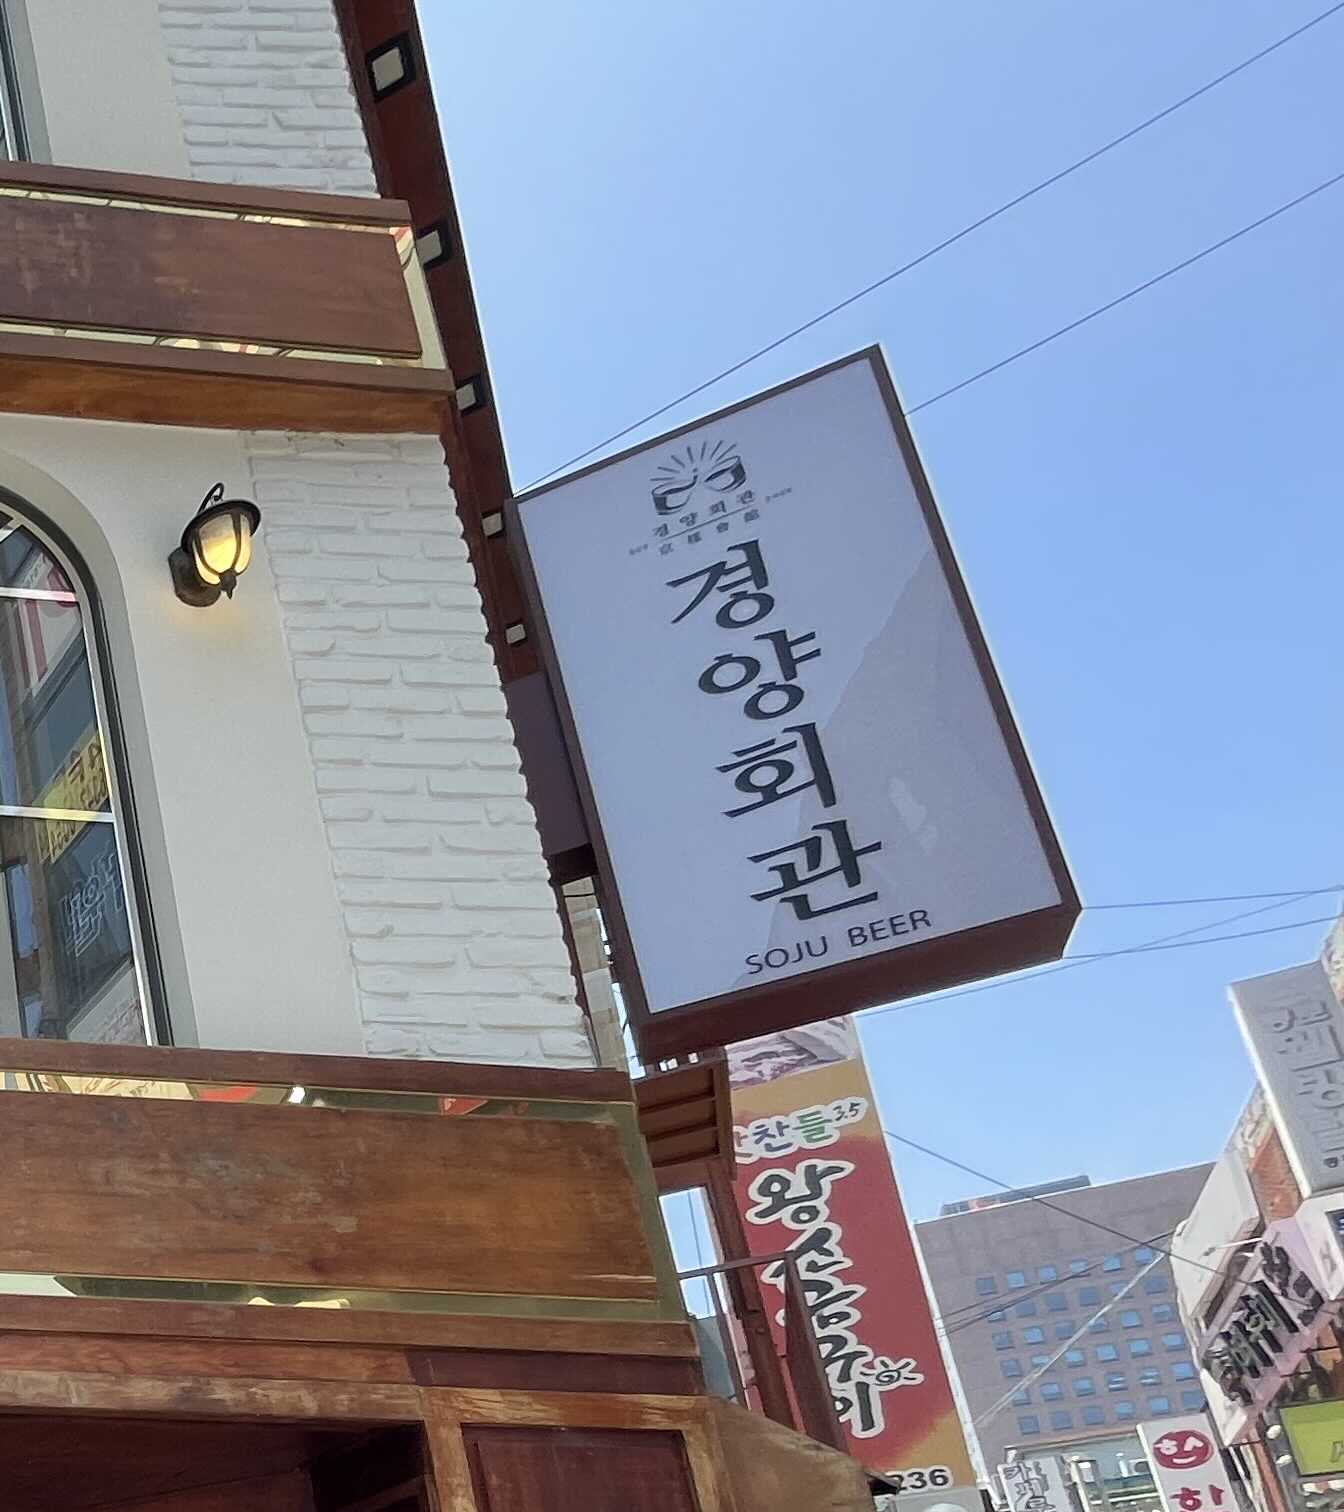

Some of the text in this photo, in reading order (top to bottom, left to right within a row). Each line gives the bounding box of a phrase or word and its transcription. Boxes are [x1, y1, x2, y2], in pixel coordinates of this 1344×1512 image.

[666, 539, 883, 921] 경양회관
[744, 908, 932, 976] SOJU BEER
